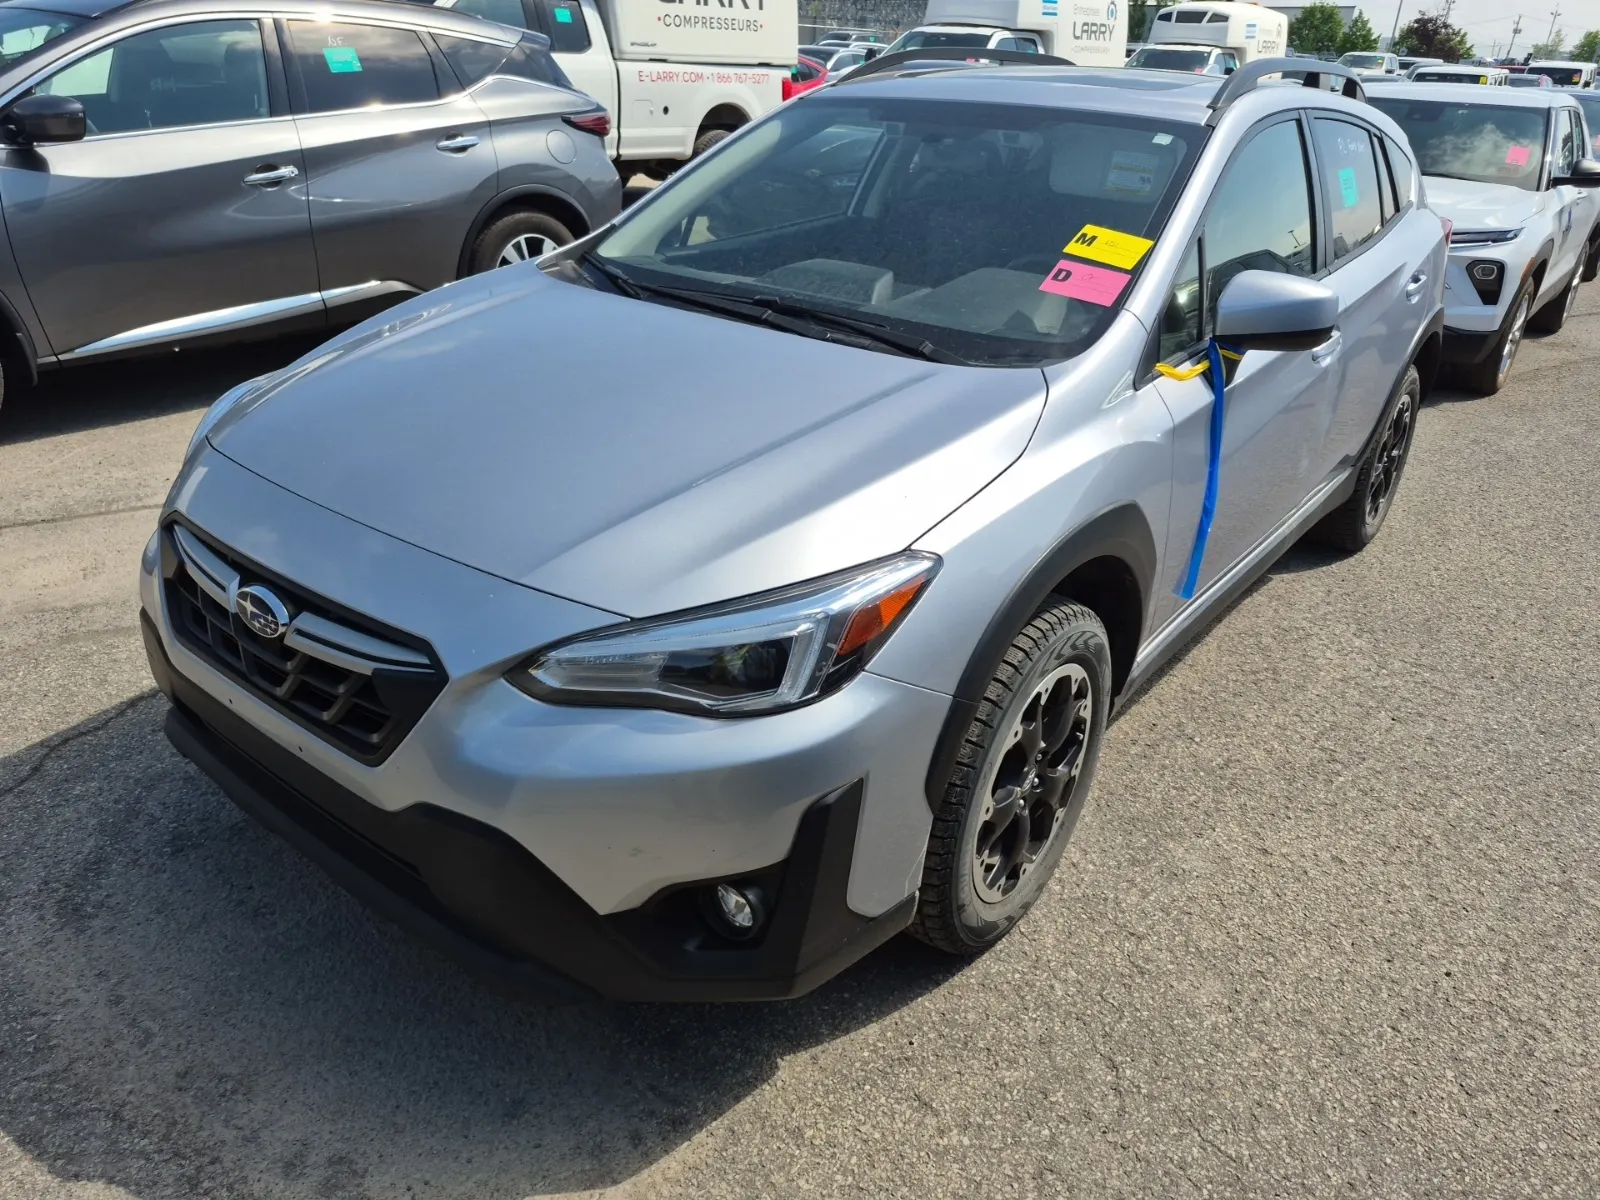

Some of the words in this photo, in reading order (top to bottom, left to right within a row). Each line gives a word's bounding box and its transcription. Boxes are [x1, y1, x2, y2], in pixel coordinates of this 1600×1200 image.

[662, 13, 759, 32] COMPRESSEURS
[1073, 21, 1115, 42] LARRY
[1257, 39, 1281, 55] LARRY
[638, 70, 704, 83] E-LARRY.COM
[717, 72, 733, 83] 866
[1074, 232, 1098, 247] M
[1050, 268, 1072, 283] D
